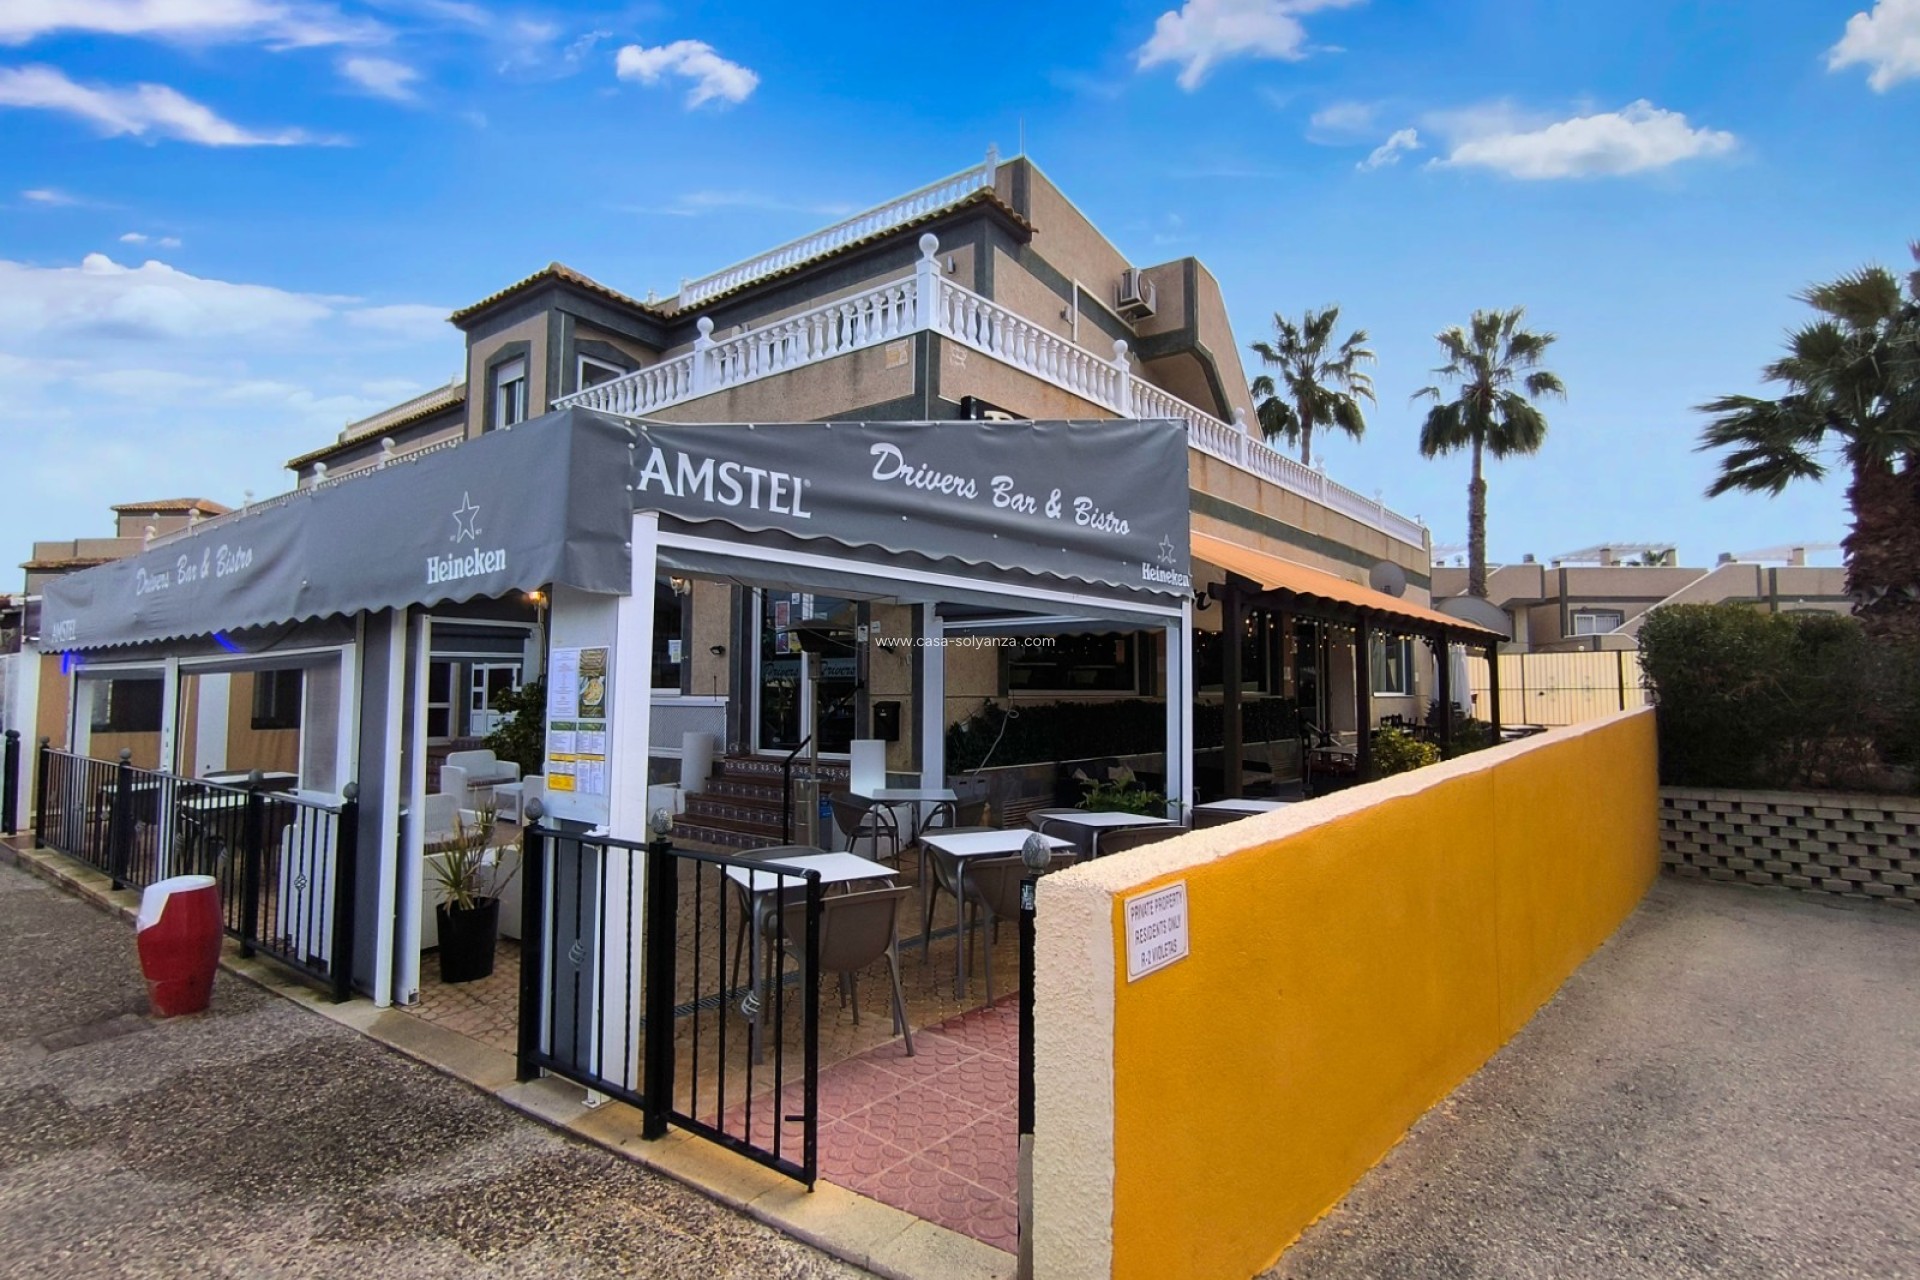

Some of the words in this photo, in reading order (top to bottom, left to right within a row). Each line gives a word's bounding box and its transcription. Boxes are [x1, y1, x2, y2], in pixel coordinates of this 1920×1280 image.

[636, 446, 811, 519] AMSTEL
[870, 442, 979, 499] Drivers
[990, 475, 1038, 515] Bar
[1045, 488, 1062, 519] &
[1073, 496, 1130, 535] Bistro
[136, 568, 170, 596] Drivers
[177, 554, 197, 585] Bar
[201, 547, 211, 579] &
[216, 544, 253, 578] Bistro
[426, 547, 507, 584] Heineken
[1142, 562, 1190, 587] Heineken
[52, 619, 76, 642] AMSTEL
[1130, 900, 1154, 922] PRIVATE
[1135, 919, 1167, 946] RESIDENTS
